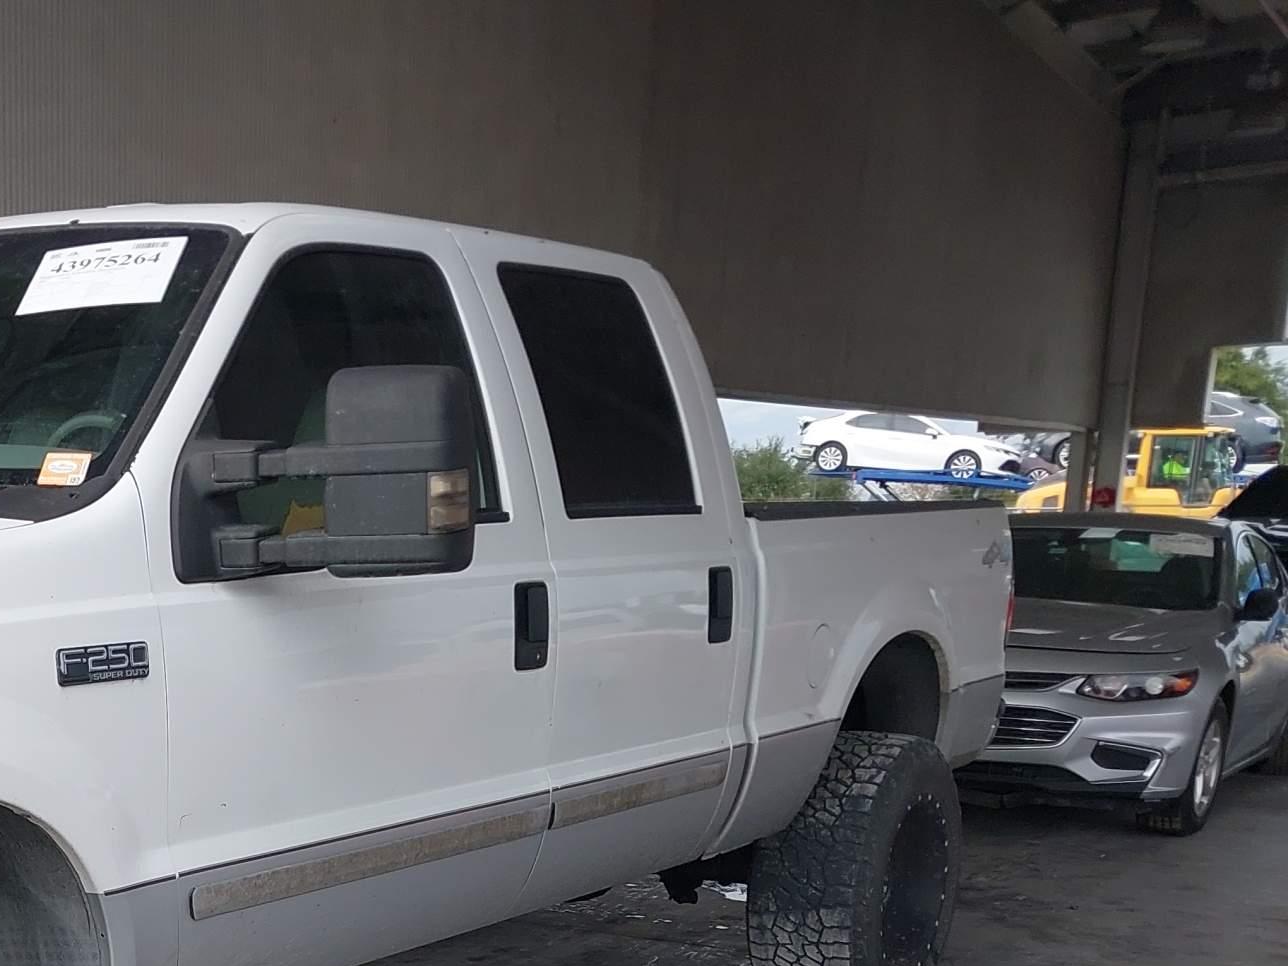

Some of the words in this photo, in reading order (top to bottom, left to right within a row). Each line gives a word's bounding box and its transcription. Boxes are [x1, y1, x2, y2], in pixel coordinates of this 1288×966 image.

[51, 252, 161, 273] 43975264
[92, 671, 124, 681] SUPER
[125, 668, 149, 678] DUTY
